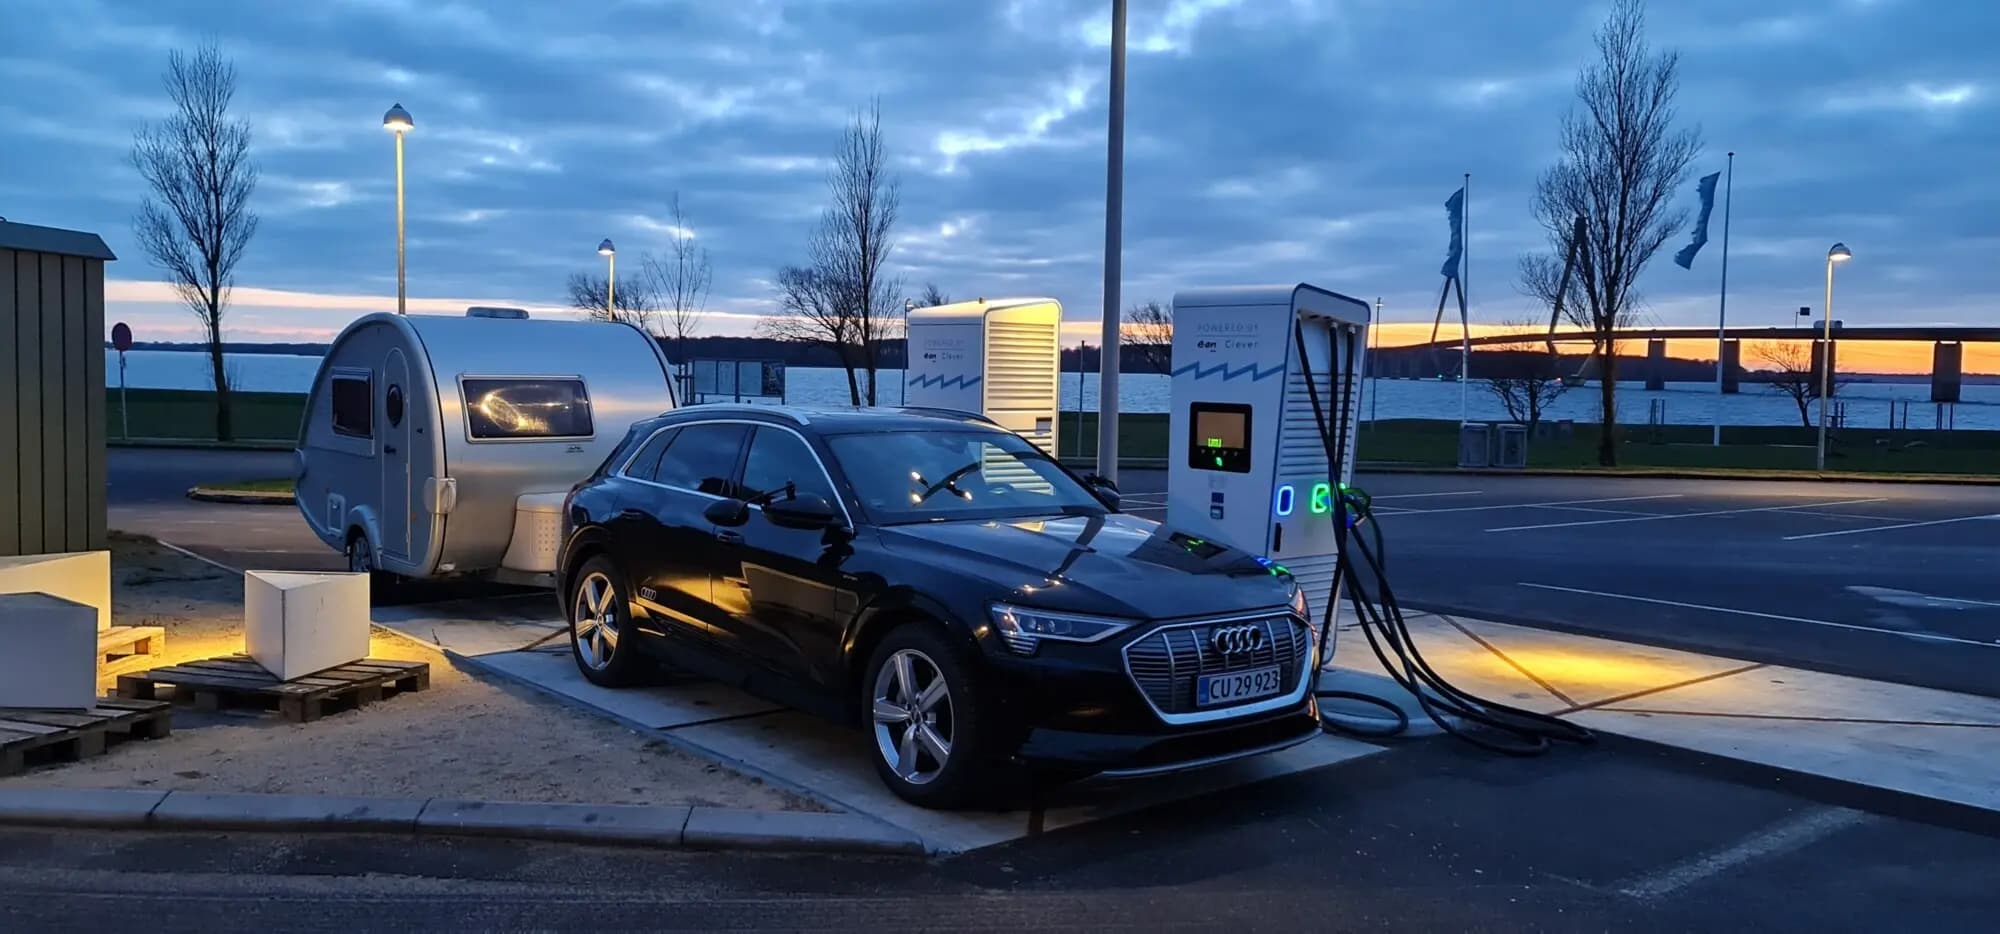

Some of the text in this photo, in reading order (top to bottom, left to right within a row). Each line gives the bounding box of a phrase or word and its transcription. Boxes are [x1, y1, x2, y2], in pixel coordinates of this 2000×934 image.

[1225, 340, 1259, 349] Clever
[1210, 678, 1231, 699] CU
[1234, 675, 1252, 697] 29
[1255, 670, 1279, 693] 923
